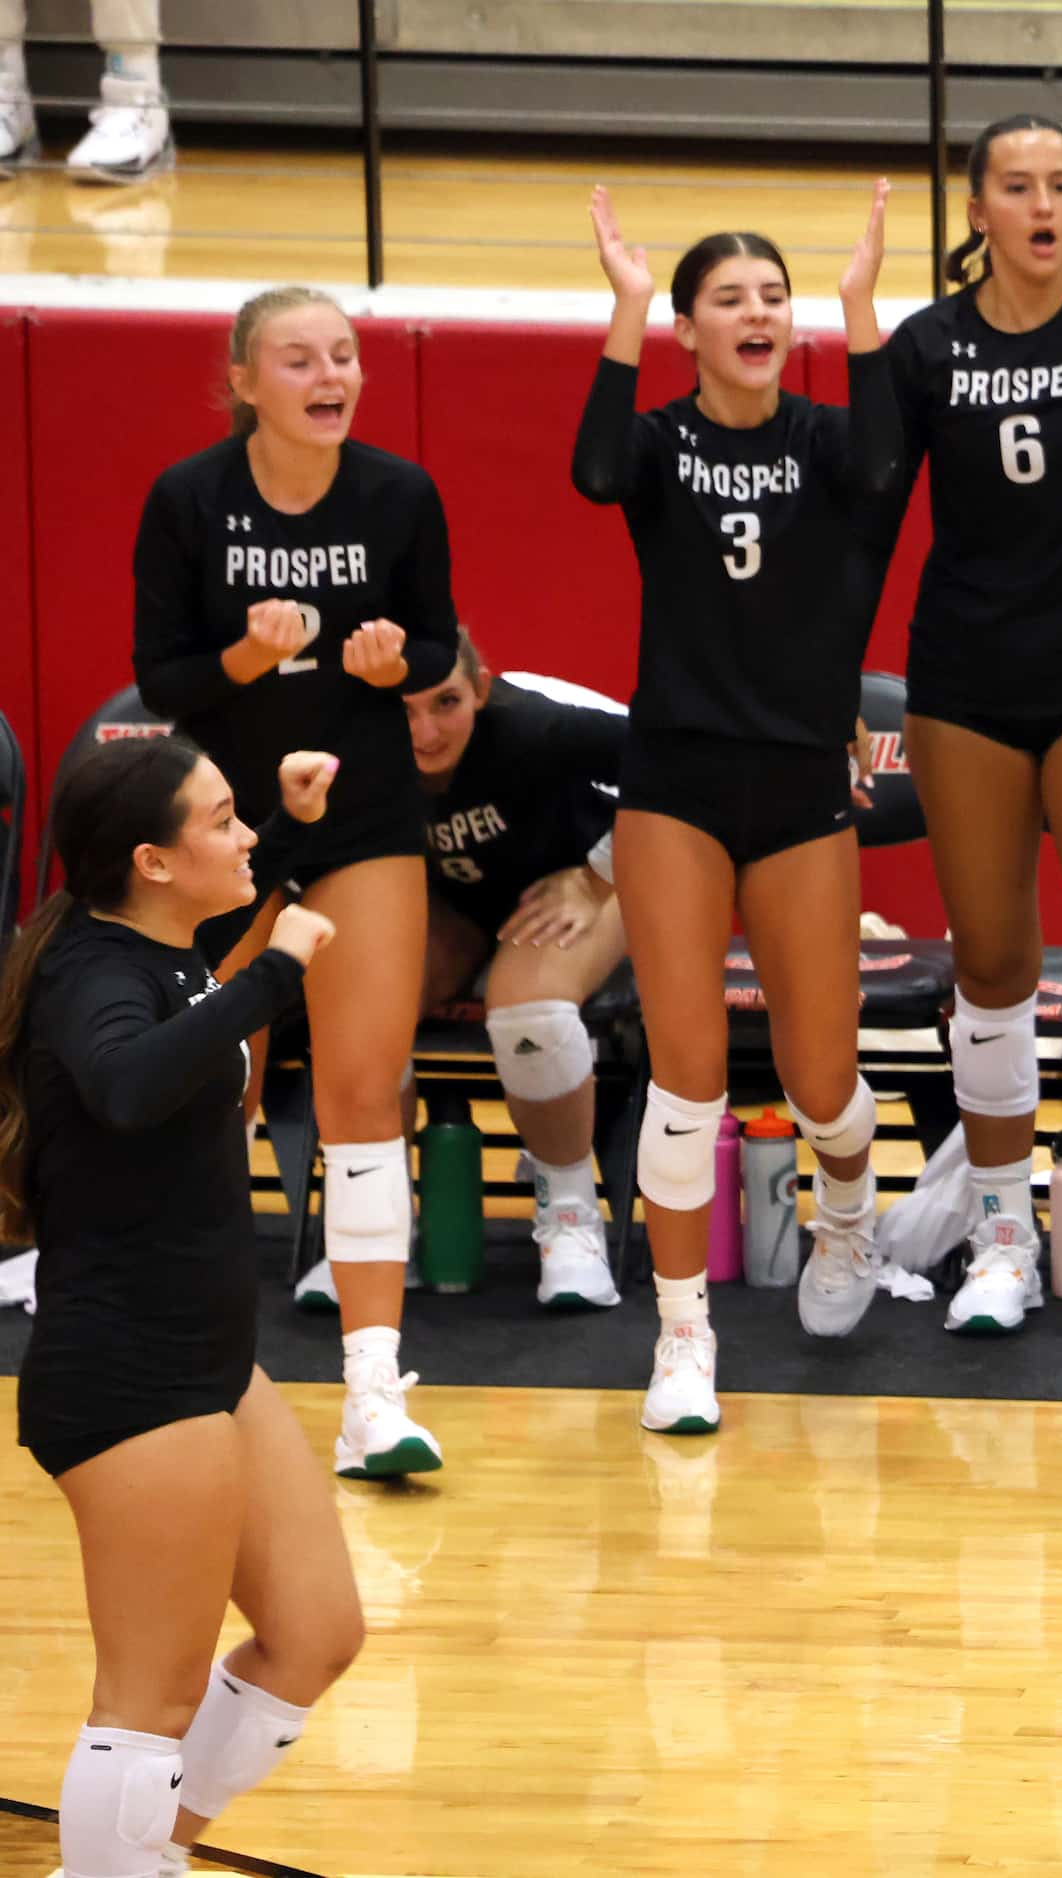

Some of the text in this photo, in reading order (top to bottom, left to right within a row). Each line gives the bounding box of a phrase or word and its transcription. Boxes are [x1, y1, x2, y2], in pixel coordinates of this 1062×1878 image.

[999, 413, 1046, 485] 6
[226, 543, 368, 589] PROSPER
[720, 511, 762, 581] 3
[278, 602, 322, 675] 2
[426, 804, 508, 853] SPER
